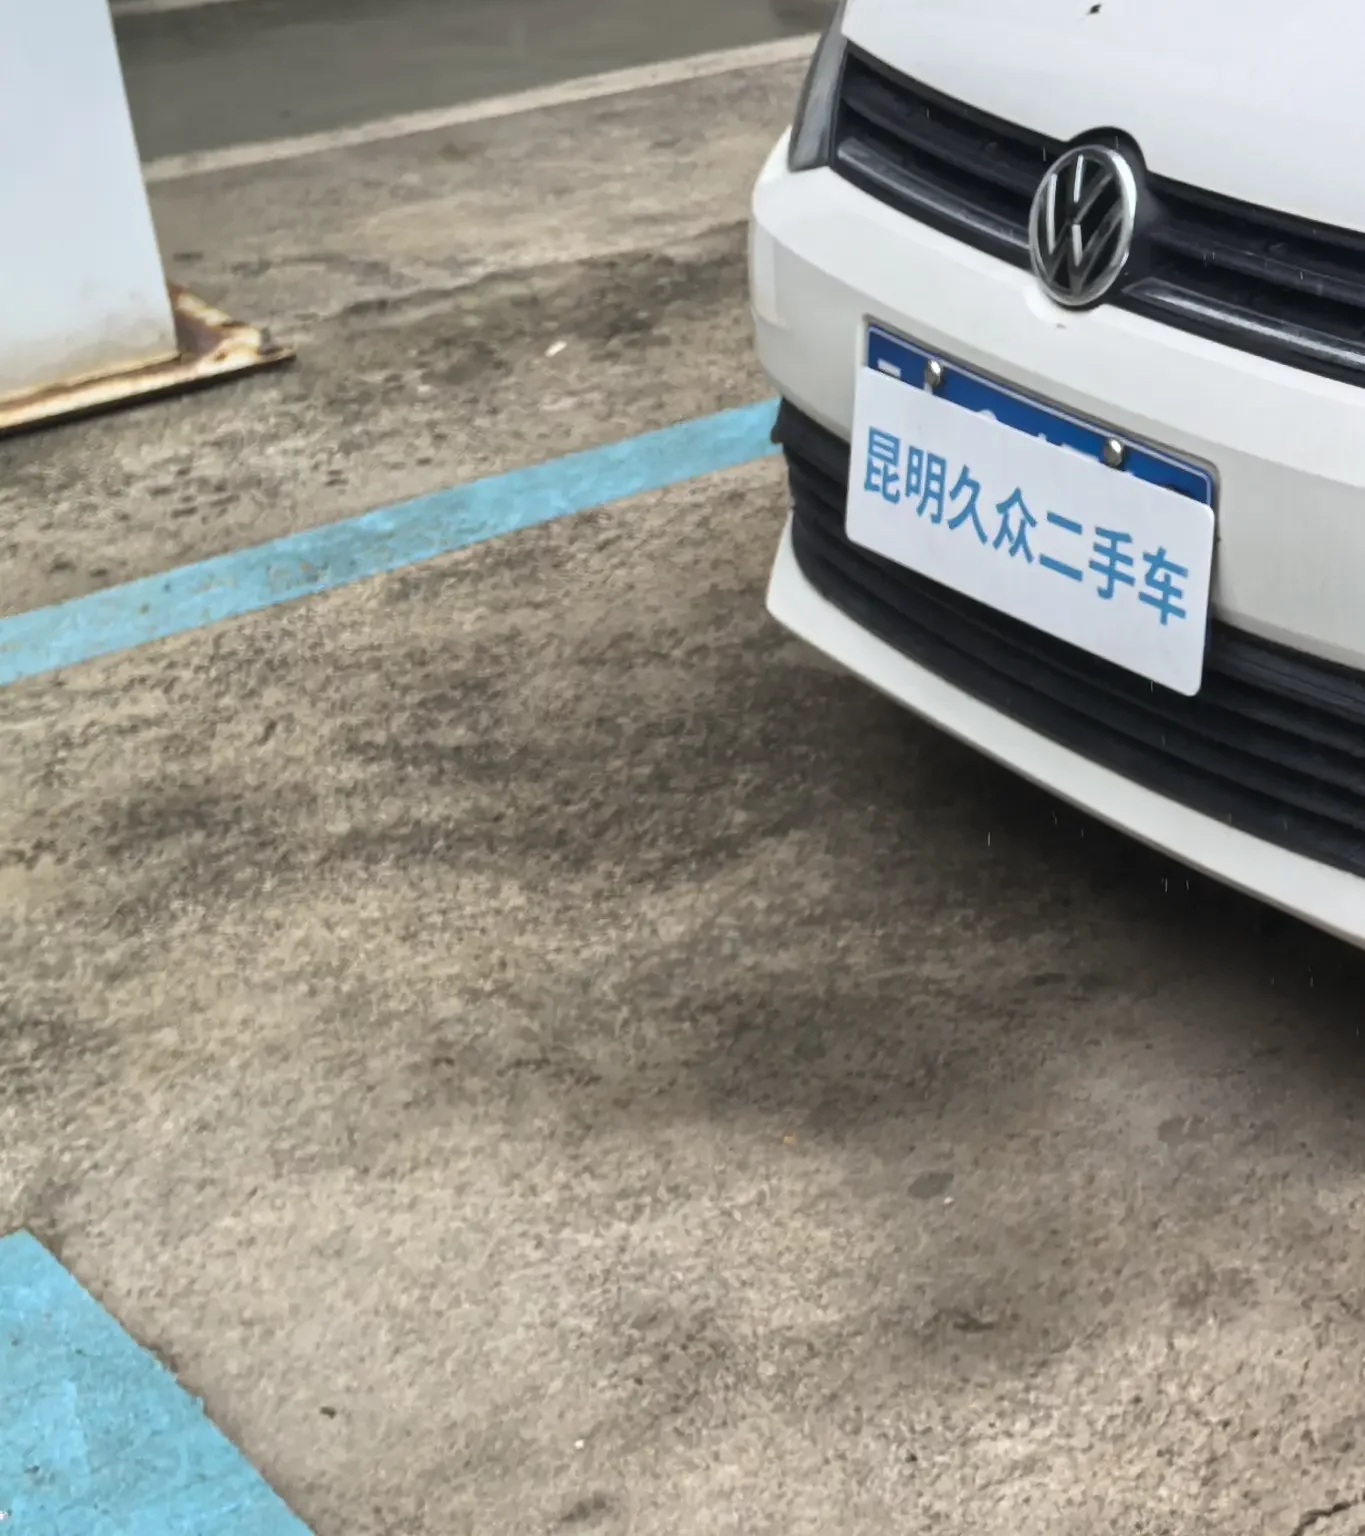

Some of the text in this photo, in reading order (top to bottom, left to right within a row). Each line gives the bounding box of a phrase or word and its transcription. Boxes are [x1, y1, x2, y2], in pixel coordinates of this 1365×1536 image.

[864, 425, 1190, 626] 昆明久众二手车
